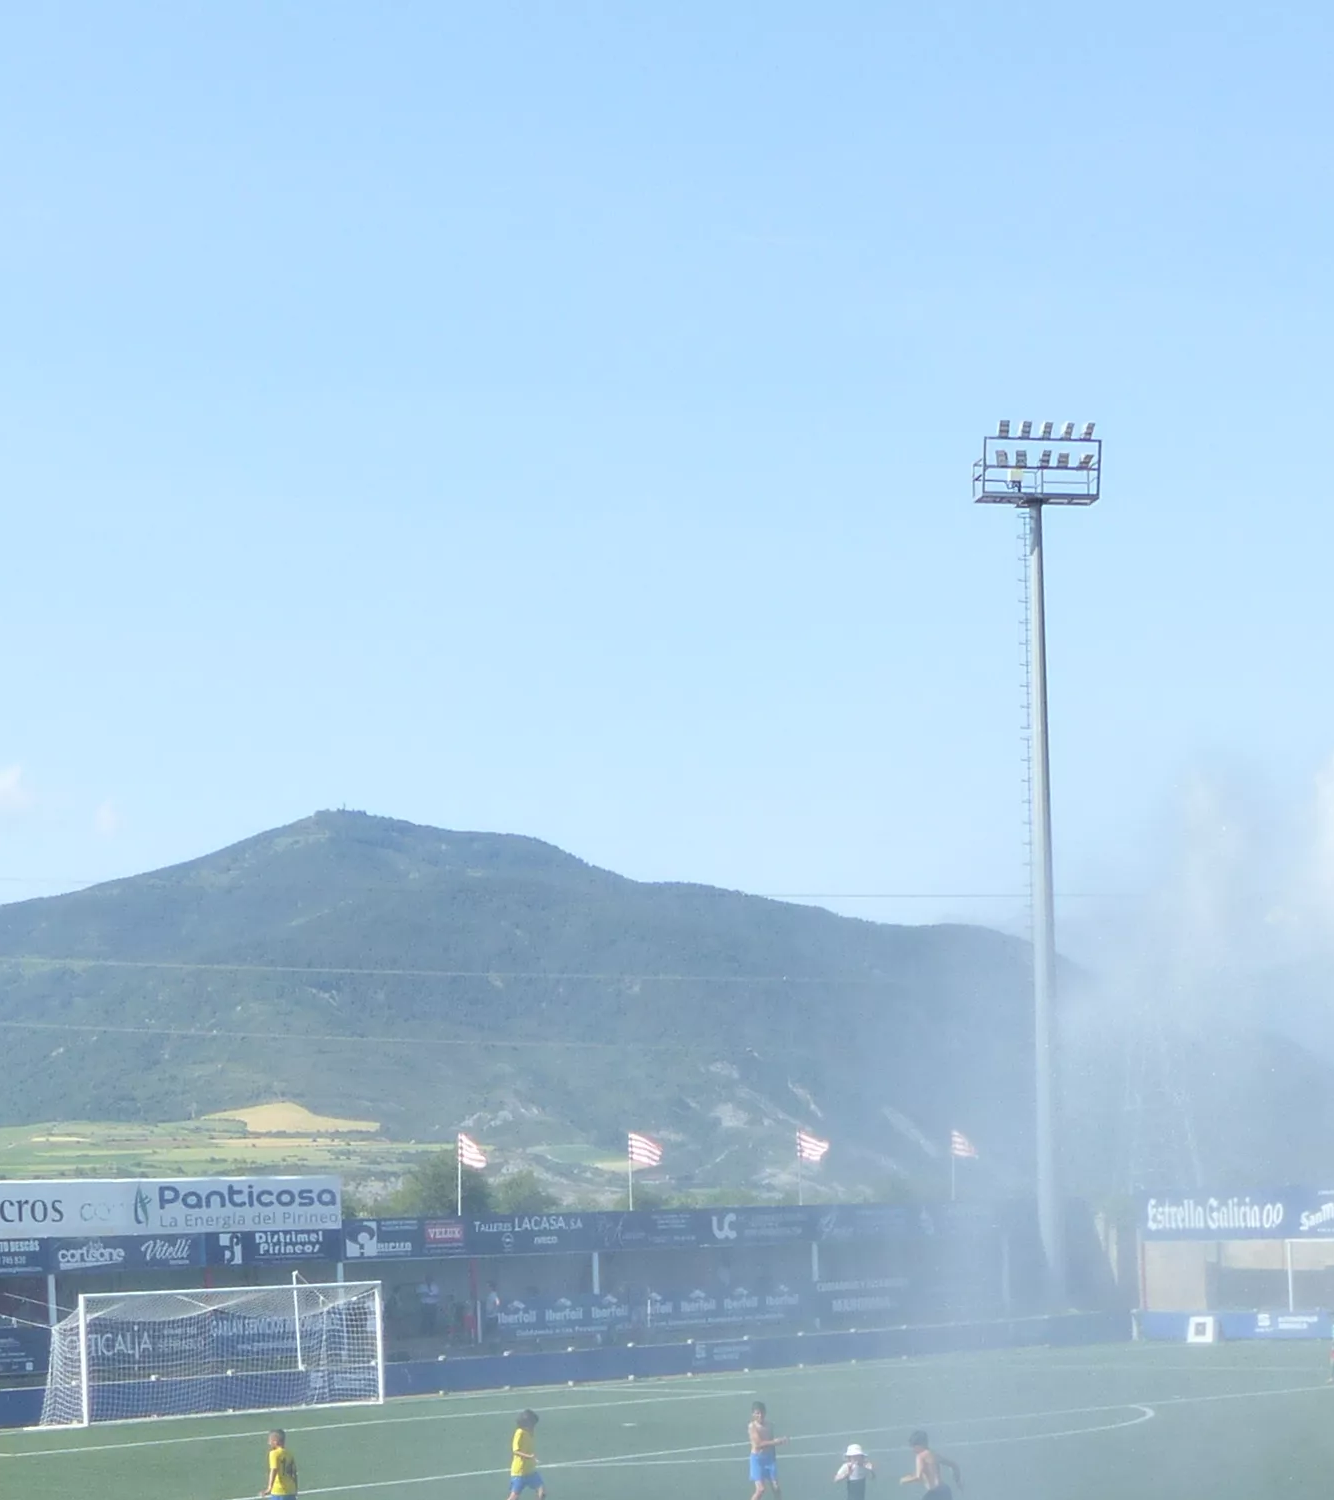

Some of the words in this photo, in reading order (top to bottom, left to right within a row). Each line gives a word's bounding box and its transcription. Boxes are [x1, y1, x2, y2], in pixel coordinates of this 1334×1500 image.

[158, 1183, 337, 1210] Panticosa
[160, 1215, 178, 1228] La
[252, 1211, 276, 1226] del
[283, 1209, 339, 1225] Pirineo
[1205, 1196, 1261, 1231] Galicia
[427, 1228, 462, 1240] VELUX
[141, 1238, 192, 1261] Vitelli
[258, 1241, 321, 1256] Pirineos
